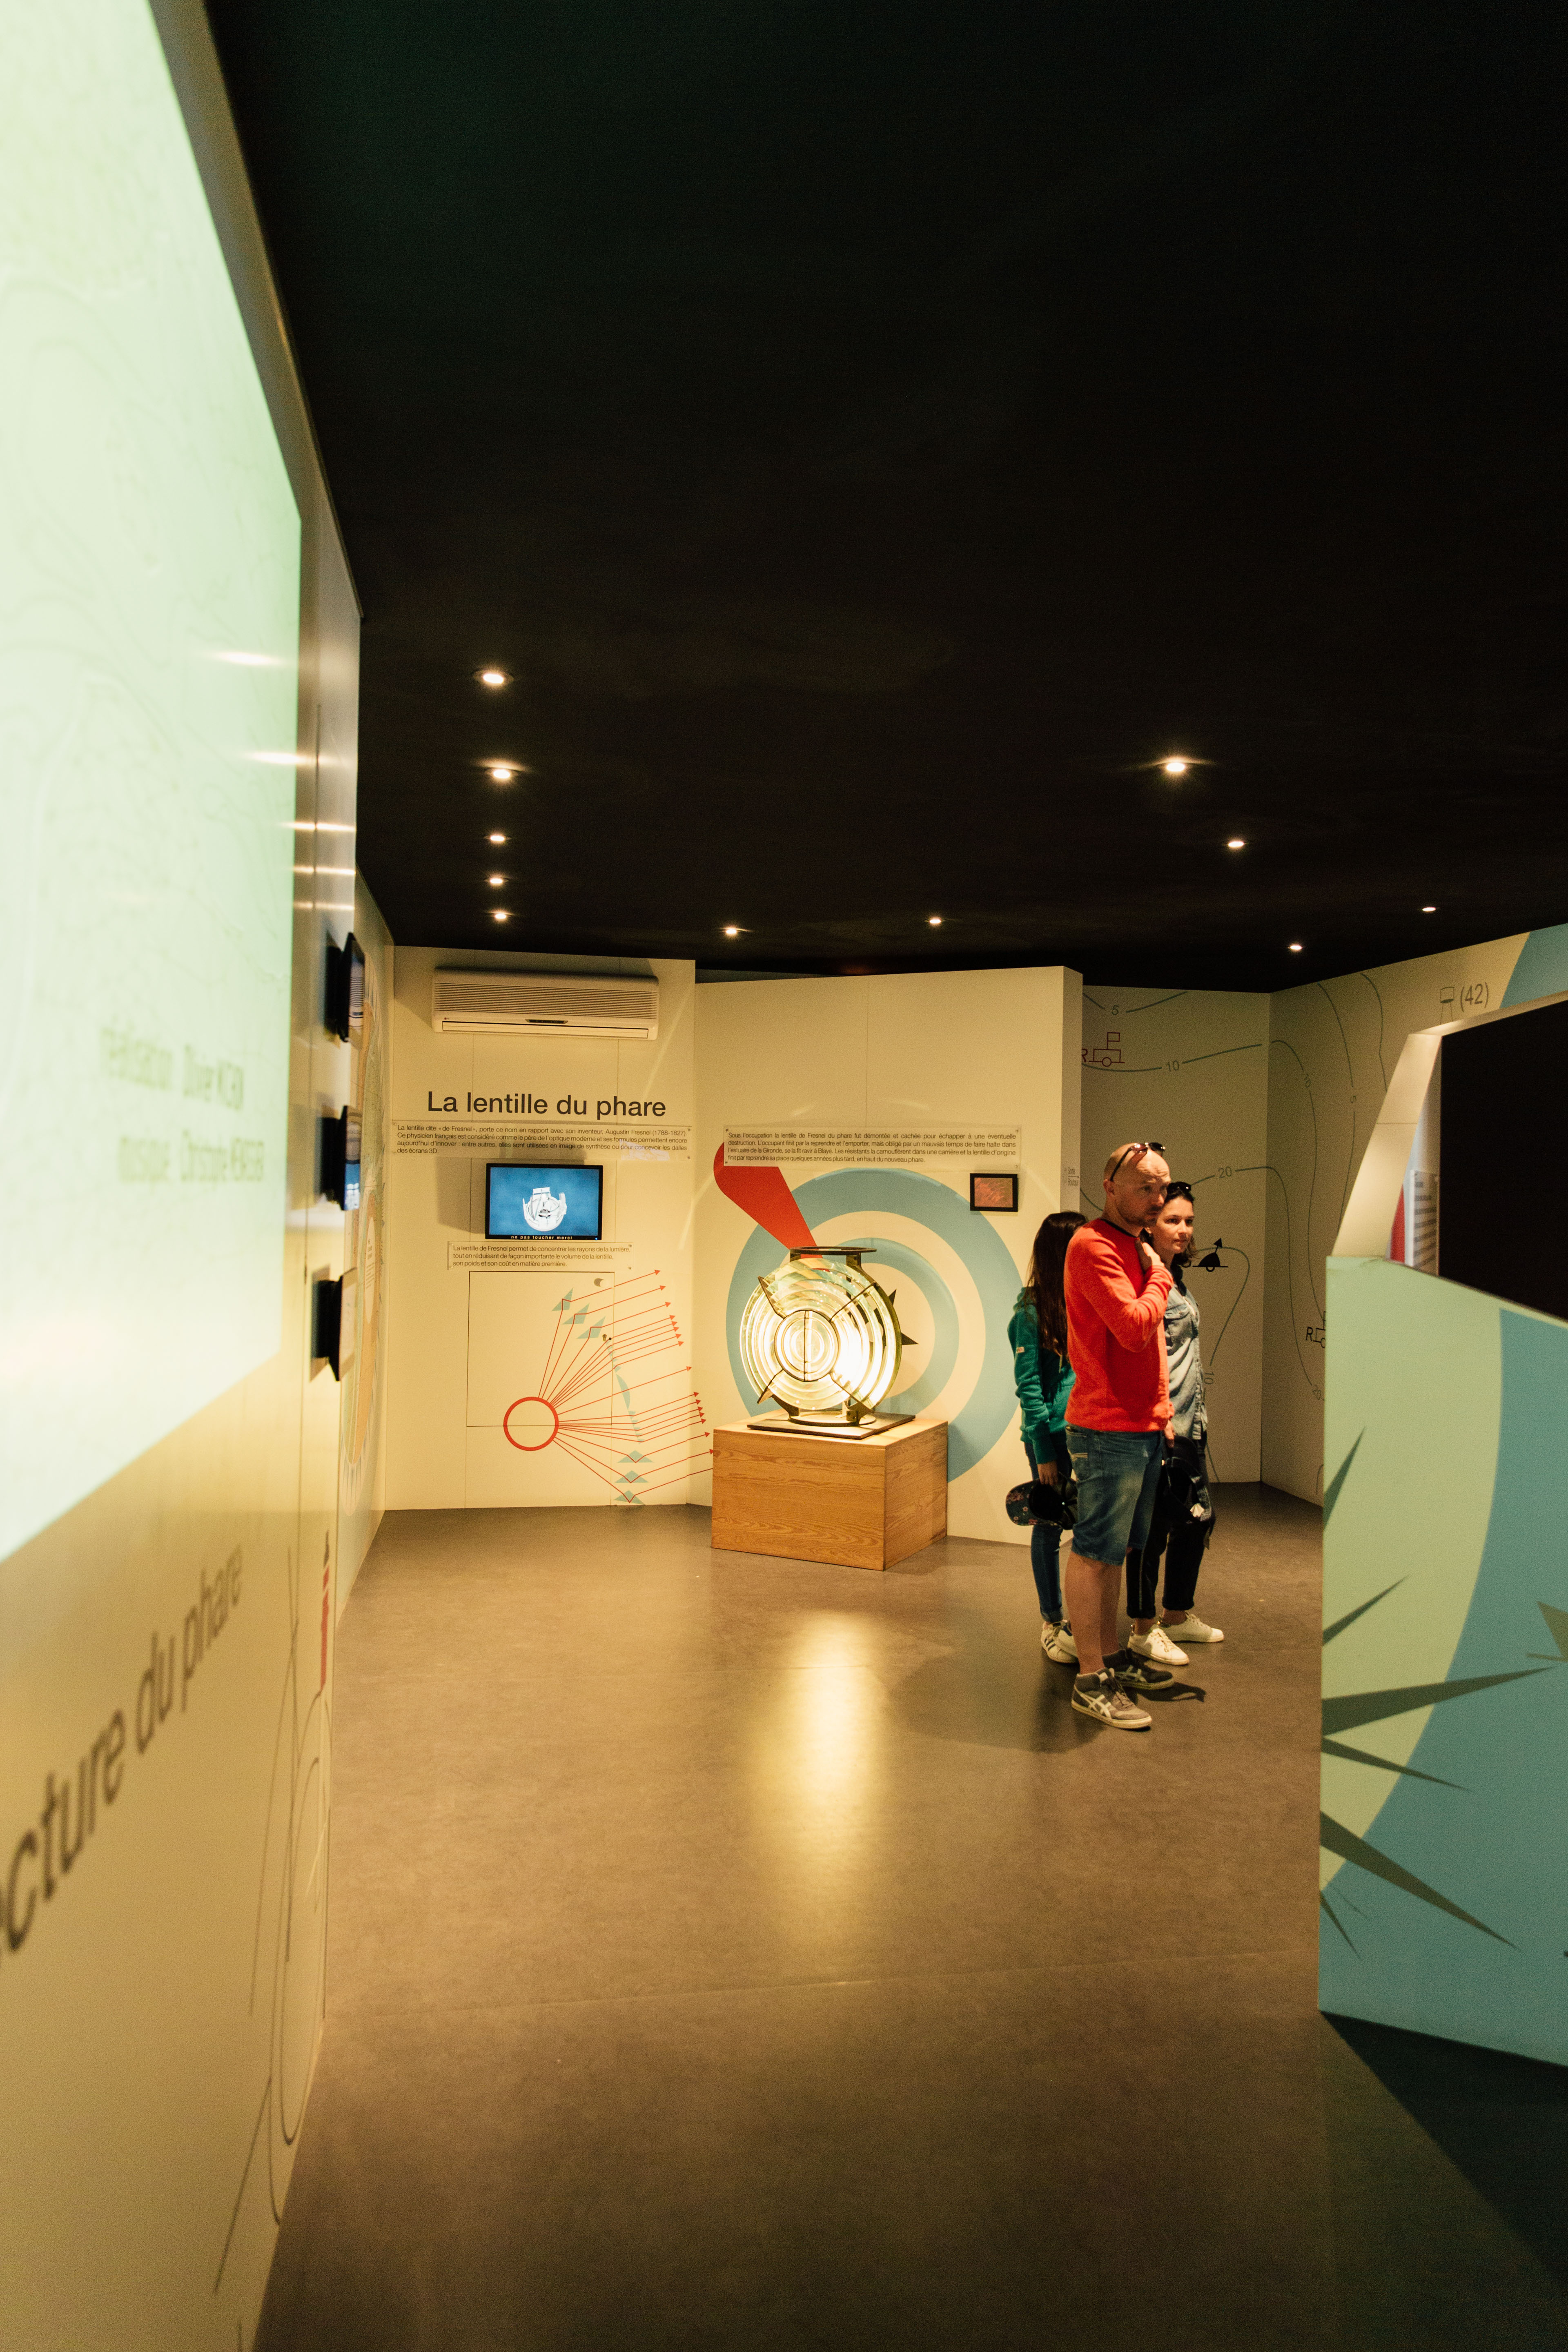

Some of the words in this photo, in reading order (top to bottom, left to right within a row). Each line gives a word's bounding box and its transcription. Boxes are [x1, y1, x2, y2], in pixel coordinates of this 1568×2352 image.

[1460, 982, 1489, 1013] (42)
[1111, 1005, 1119, 1015] 5
[1166, 1060, 1180, 1071] 10
[428, 1091, 458, 1112] La
[467, 1092, 548, 1114] lentille
[557, 1095, 587, 1116] du
[597, 1096, 666, 1120] phare
[1218, 1166, 1232, 1178] 20
[1306, 1326, 1313, 1341] R
[0, 1709, 125, 1954] cture
[137, 1631, 175, 1755] du
[182, 1544, 242, 1713] phare
